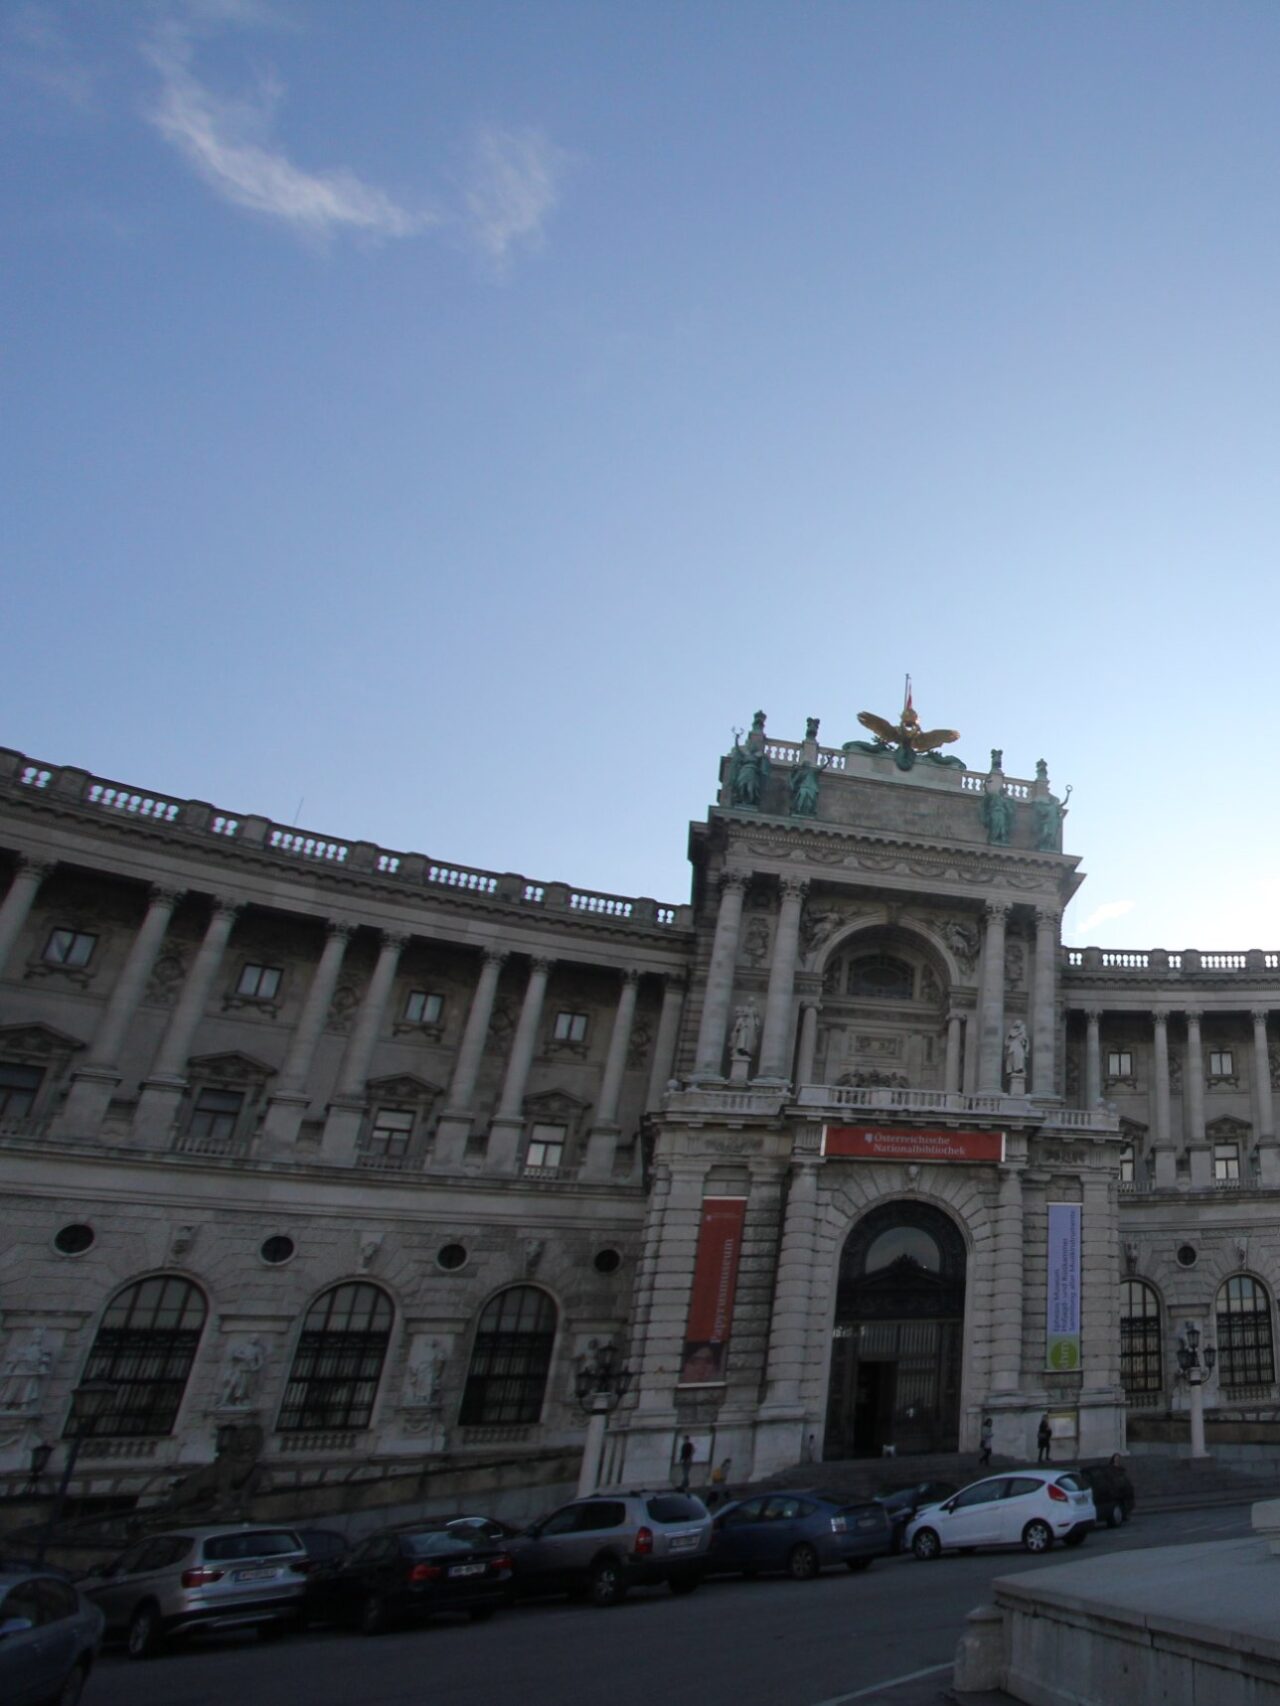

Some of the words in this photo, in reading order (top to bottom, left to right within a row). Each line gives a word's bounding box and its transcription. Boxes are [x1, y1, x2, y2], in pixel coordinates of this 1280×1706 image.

[874, 1131, 950, 1145] Österreichische
[873, 1143, 966, 1156] Nationalbibliothek
[709, 1238, 735, 1344] Papyrusmuseum
